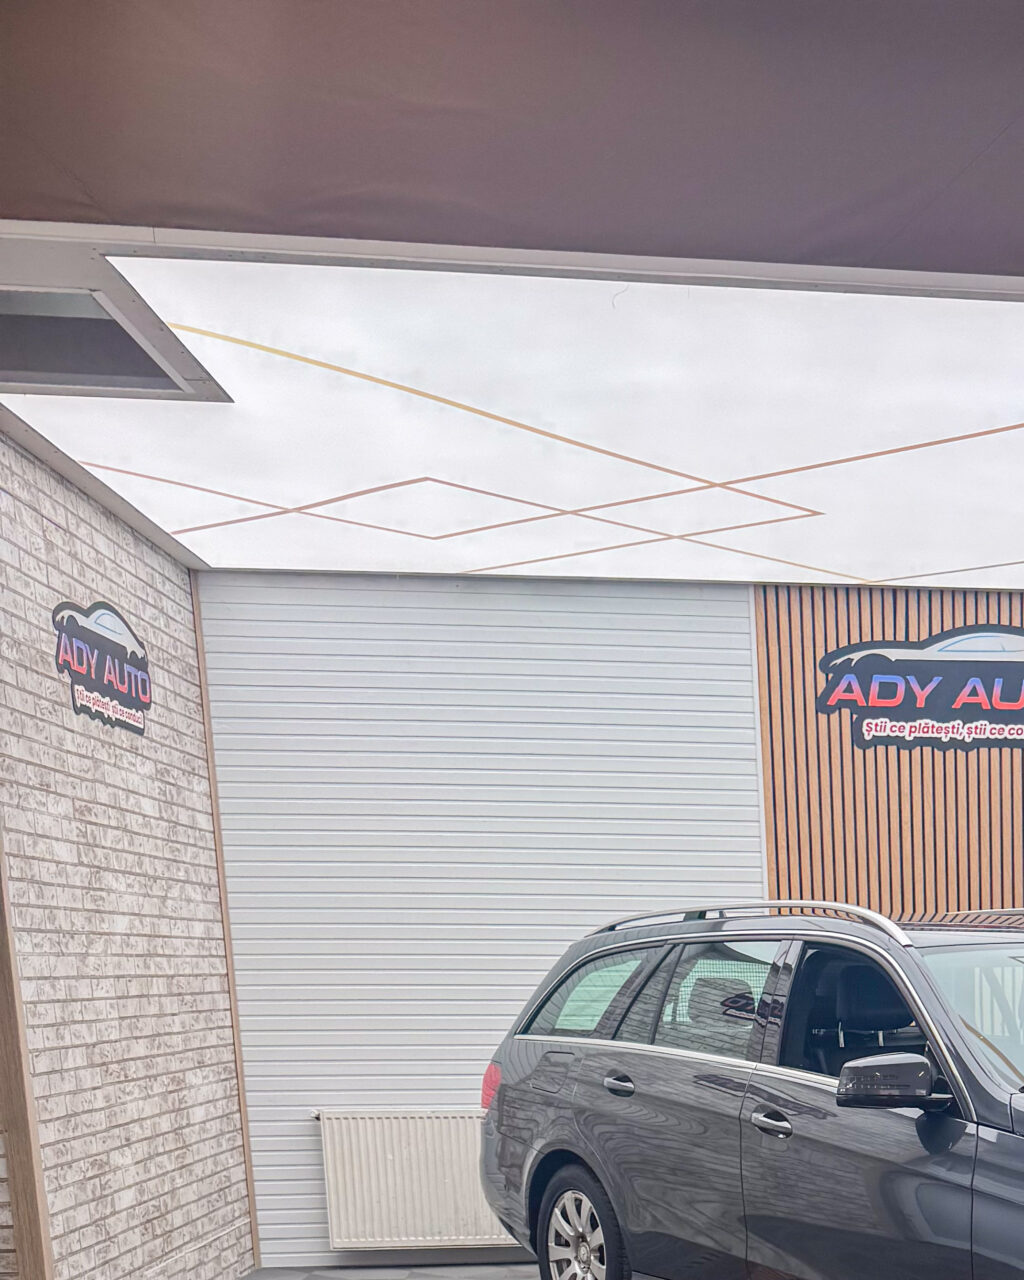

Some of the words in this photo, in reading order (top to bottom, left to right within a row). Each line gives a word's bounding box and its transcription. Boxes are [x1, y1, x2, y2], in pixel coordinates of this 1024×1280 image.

[58, 632, 98, 680] ADY
[104, 654, 151, 703] AUTO
[827, 673, 943, 708] ADY
[889, 723, 906, 734] ce
[989, 725, 1005, 736] ce
